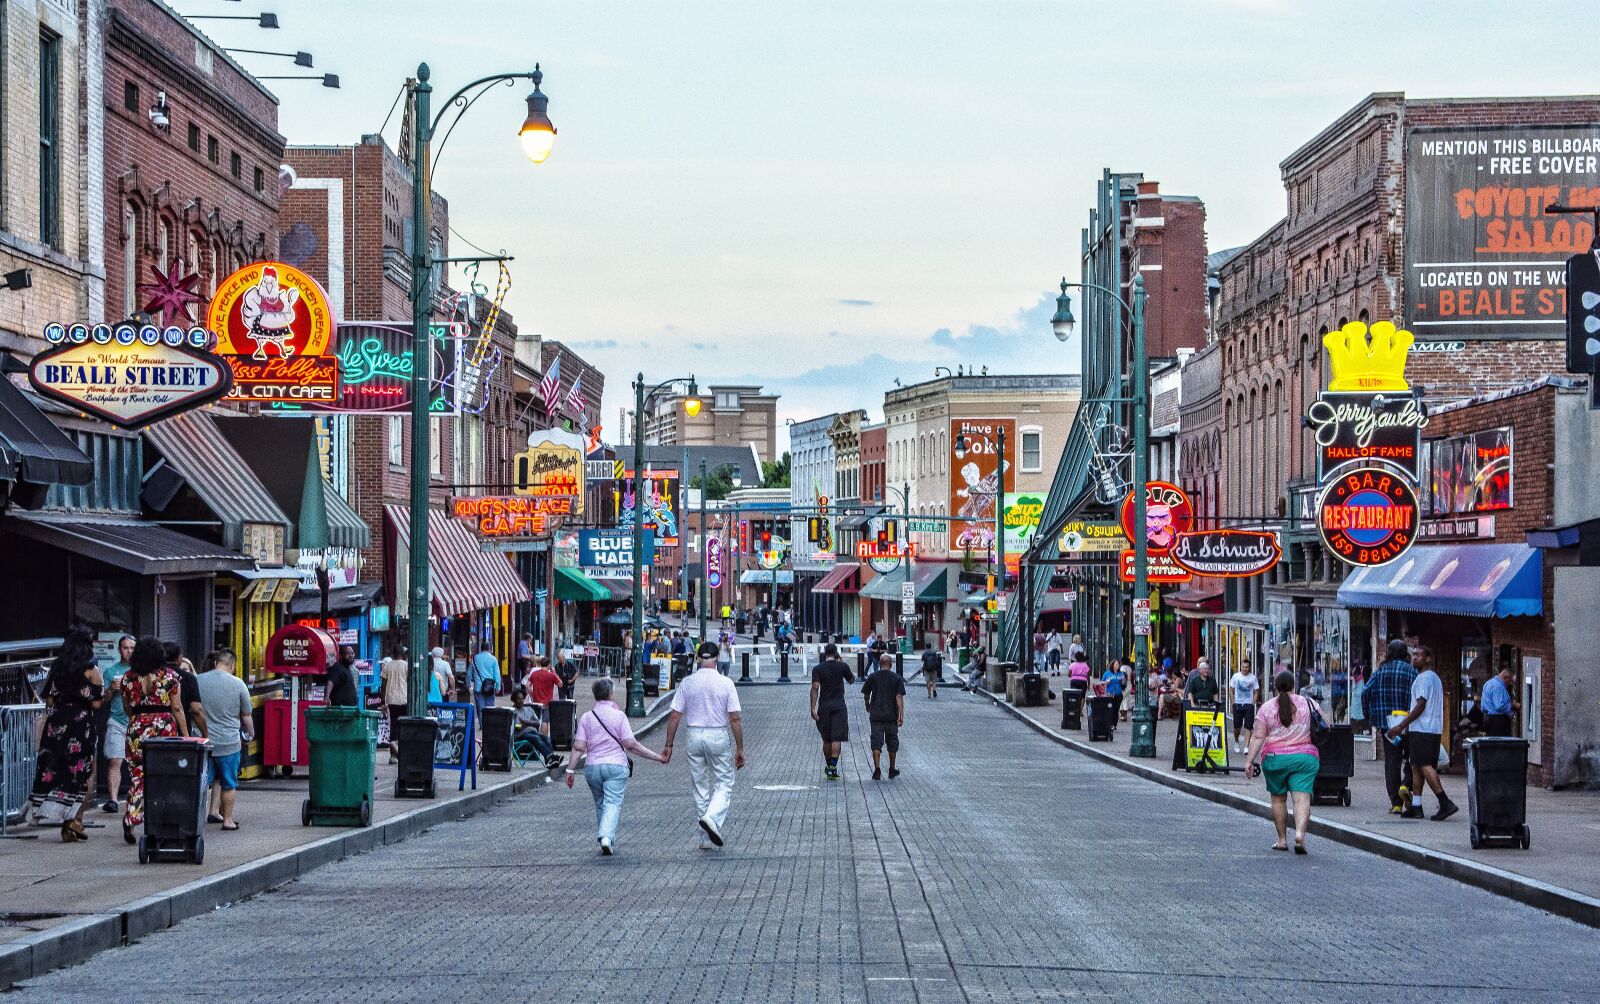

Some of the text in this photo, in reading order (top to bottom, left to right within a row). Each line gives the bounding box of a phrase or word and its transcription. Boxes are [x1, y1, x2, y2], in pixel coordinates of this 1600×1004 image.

[1422, 138, 1600, 156] MENTION THIS BILLBOAR
[1490, 156, 1597, 174] FREE COVER
[1455, 185, 1561, 219] COYOTE
[1487, 219, 1594, 252] SALOO
[1420, 272, 1483, 287] LOCATED
[1487, 271, 1509, 285] ON
[1513, 270, 1542, 285] THE
[218, 281, 241, 313] PEACE
[240, 270, 260, 286] AND
[285, 272, 324, 347] CHICKEN GREASE
[1439, 289, 1526, 316] BEALE
[47, 323, 207, 345] WELCOME
[1407, 342, 1459, 352] AMAR
[98, 353, 130, 365] World
[131, 353, 167, 365] Famous
[361, 336, 413, 384] Swee
[44, 364, 210, 386] BEALE STREET
[252, 385, 287, 398] CITY
[289, 384, 333, 399] CAFE
[961, 422, 992, 434] Have
[954, 436, 1005, 455] Cok
[1327, 447, 1413, 458] HALL OF FAME
[1347, 472, 1392, 493] BAR
[480, 516, 545, 535] CAFE
[1323, 504, 1414, 530] RESTAURANT
[1086, 523, 1124, 537] O'SULLIVA
[589, 537, 635, 551] BLUE
[1175, 535, 1275, 558] A. Schwab
[1330, 532, 1408, 563] 159 BEALE
[588, 568, 633, 577] JUKE JOIN
[1146, 565, 1187, 576] TTITUDE.
[283, 639, 309, 647] GRAB
